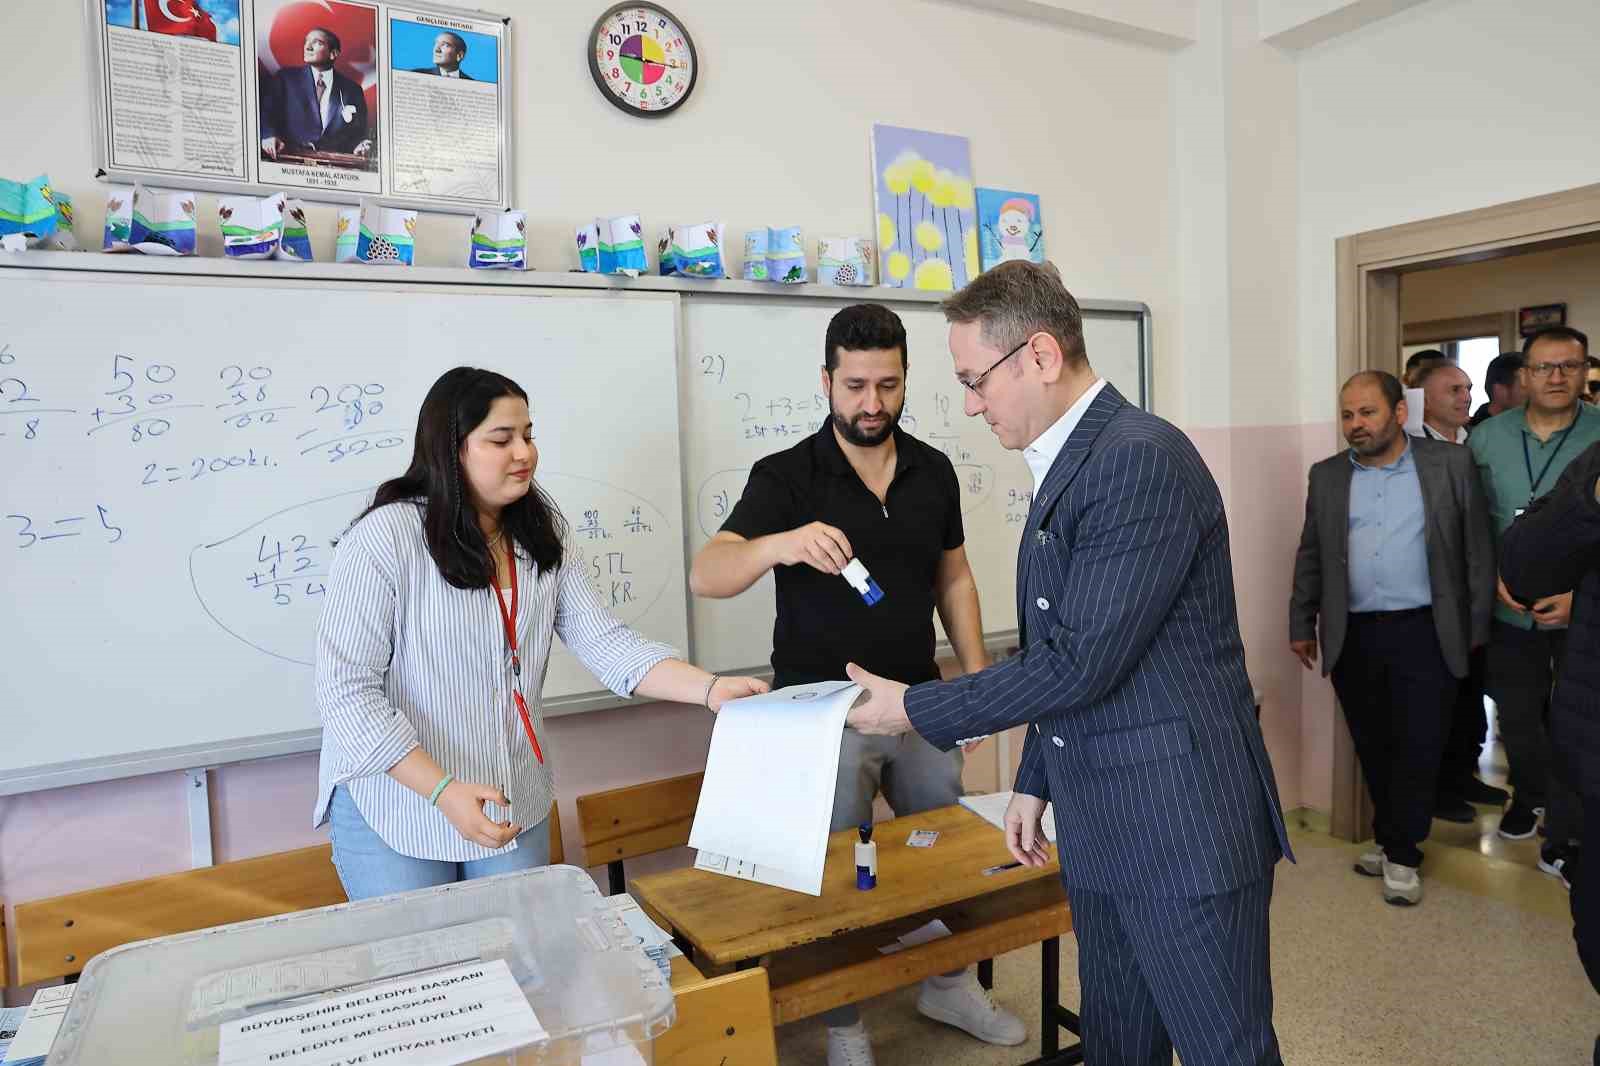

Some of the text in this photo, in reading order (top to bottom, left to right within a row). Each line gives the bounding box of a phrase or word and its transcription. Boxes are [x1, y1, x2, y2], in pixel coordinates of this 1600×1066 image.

[621, 23, 631, 35] 11
[635, 21, 648, 33] 12
[609, 33, 622, 46] 10
[606, 50, 615, 61] 9
[611, 67, 620, 79] 8
[665, 75, 673, 85] 4
[624, 82, 632, 92] 7
[655, 86, 663, 97] 5
[639, 88, 648, 99] 6
[240, 969, 484, 1034] BÜYÜKŞEHİR BELEDİYE BAŞKANI
[300, 994, 447, 1035] BELEDİYE BAŞKANI
[269, 1001, 484, 1062] BELEDİYE MECLİSİ ÜYELERİ
[346, 1024, 496, 1066] VE İHTİYAR HEYETİ
